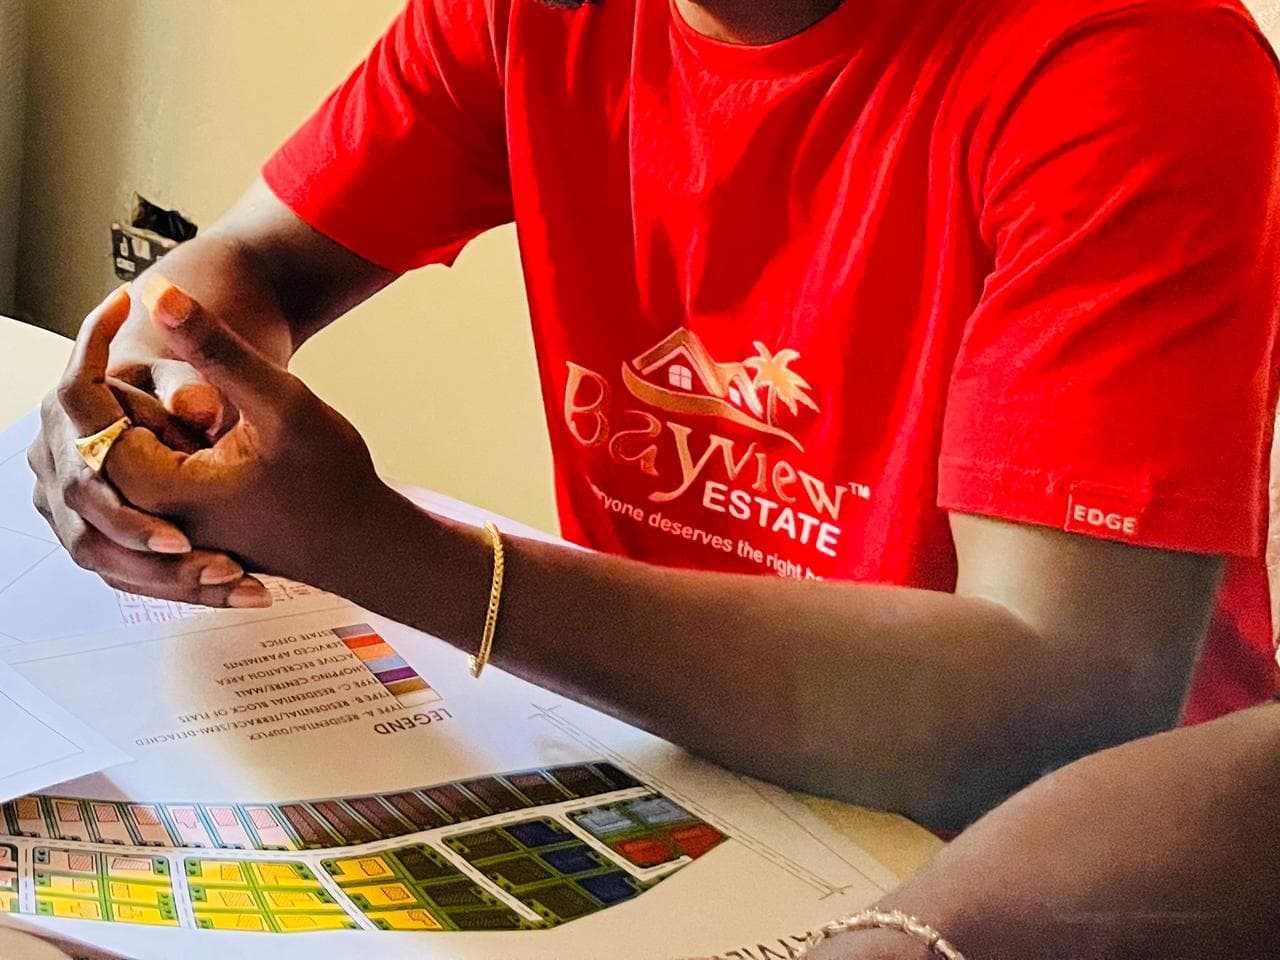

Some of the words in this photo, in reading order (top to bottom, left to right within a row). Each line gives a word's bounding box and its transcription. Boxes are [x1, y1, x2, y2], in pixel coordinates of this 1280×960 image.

[702, 480, 841, 557] ESTATE
[1073, 504, 1137, 534] EDGE
[649, 513, 733, 553] deserves
[737, 540, 764, 565] the
[766, 553, 803, 581] right
[260, 636, 297, 648] OFFICE
[300, 630, 334, 642] ESTATE
[293, 641, 344, 656] SERVICED
[223, 651, 290, 670] APARTMENTS
[317, 653, 354, 666] ACTIVE
[248, 661, 316, 681] RECREATION
[311, 665, 367, 681] SHOPPING
[216, 675, 245, 686] AREA
[234, 677, 308, 698] CENTRE/MALL
[355, 678, 379, 689] TYPE
[269, 687, 336, 706] RESIDENTIAL
[367, 691, 390, 703] TYPE
[213, 709, 228, 717] OF
[230, 701, 269, 714] BLOCK
[377, 703, 403, 715] TYPE
[178, 711, 210, 723] FLATS
[373, 708, 453, 735] LEGEND
